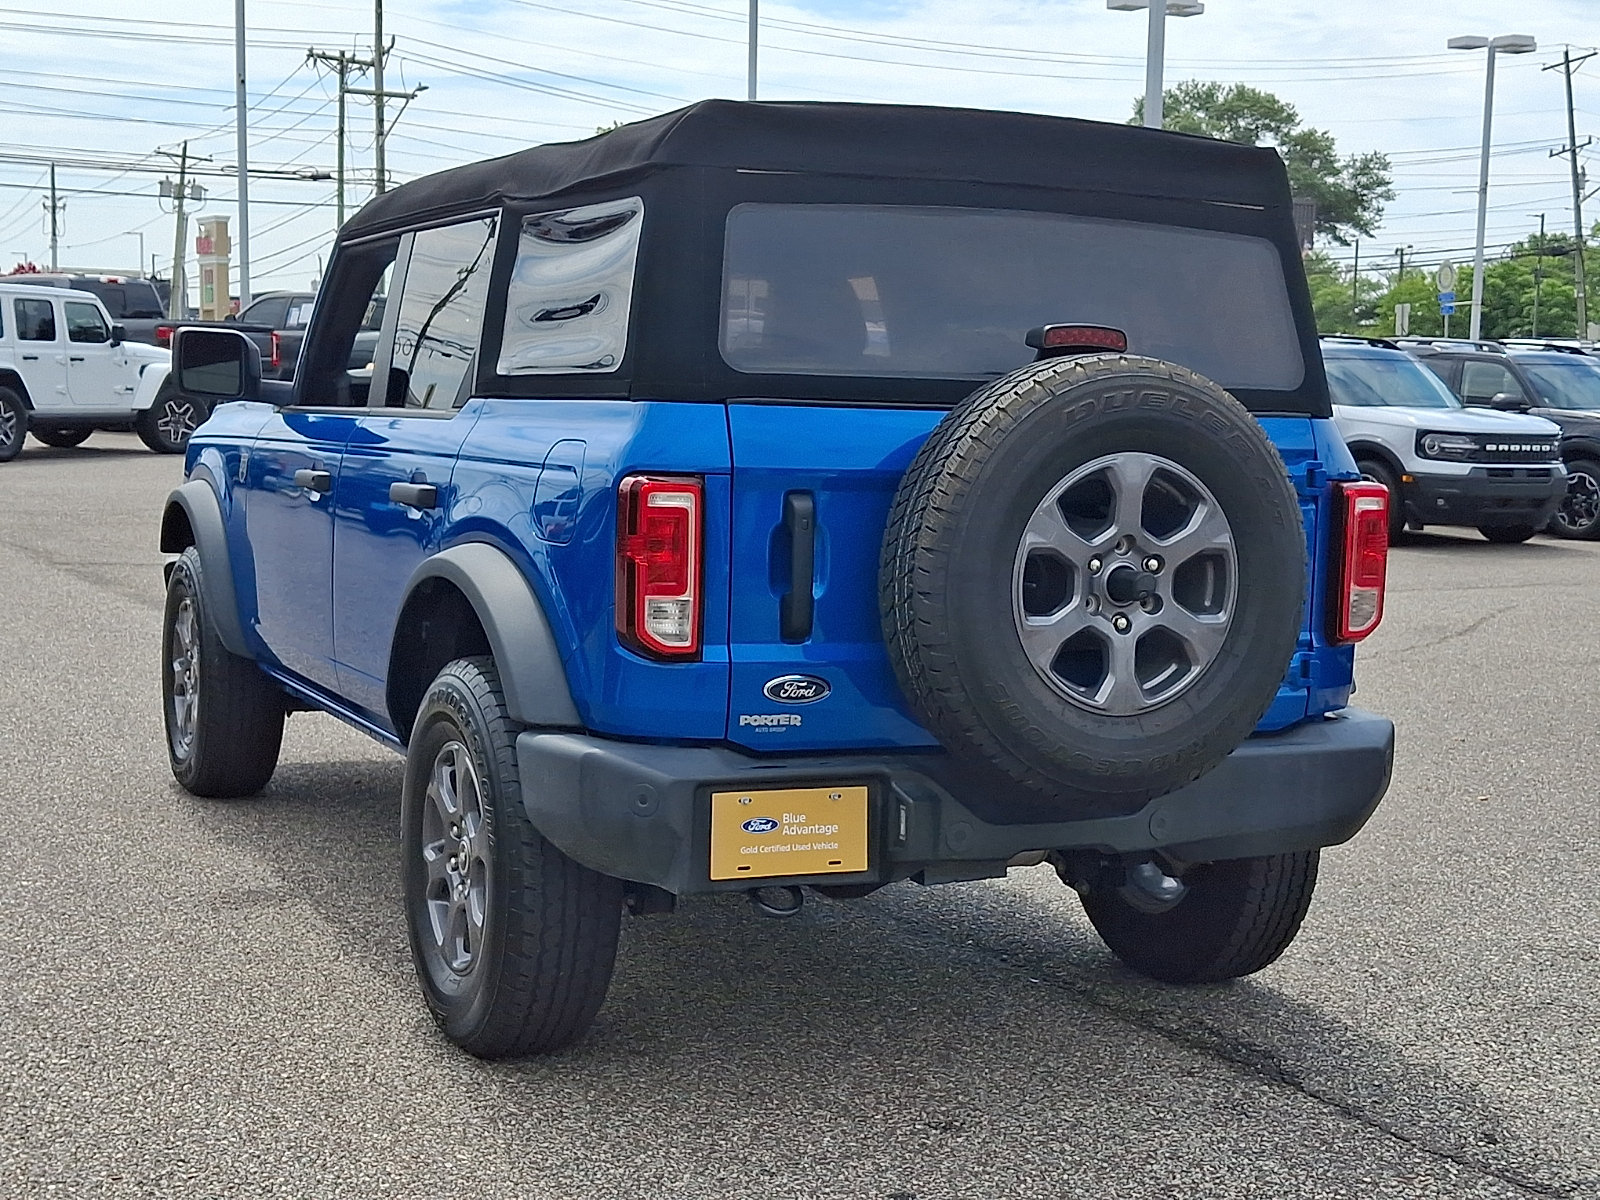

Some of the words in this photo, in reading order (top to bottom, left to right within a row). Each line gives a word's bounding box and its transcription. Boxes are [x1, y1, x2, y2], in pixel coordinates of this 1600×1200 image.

[1063, 390, 1256, 457] DUELER
[780, 681, 816, 698] Ford
[739, 714, 802, 726] PORTER
[782, 812, 806, 824] Blue
[747, 819, 772, 831] Ford
[782, 824, 839, 836] Advantage
[740, 846, 758, 855] Gold
[759, 844, 791, 853] Certified
[792, 843, 811, 851] Used
[812, 841, 839, 850] Vehicle
